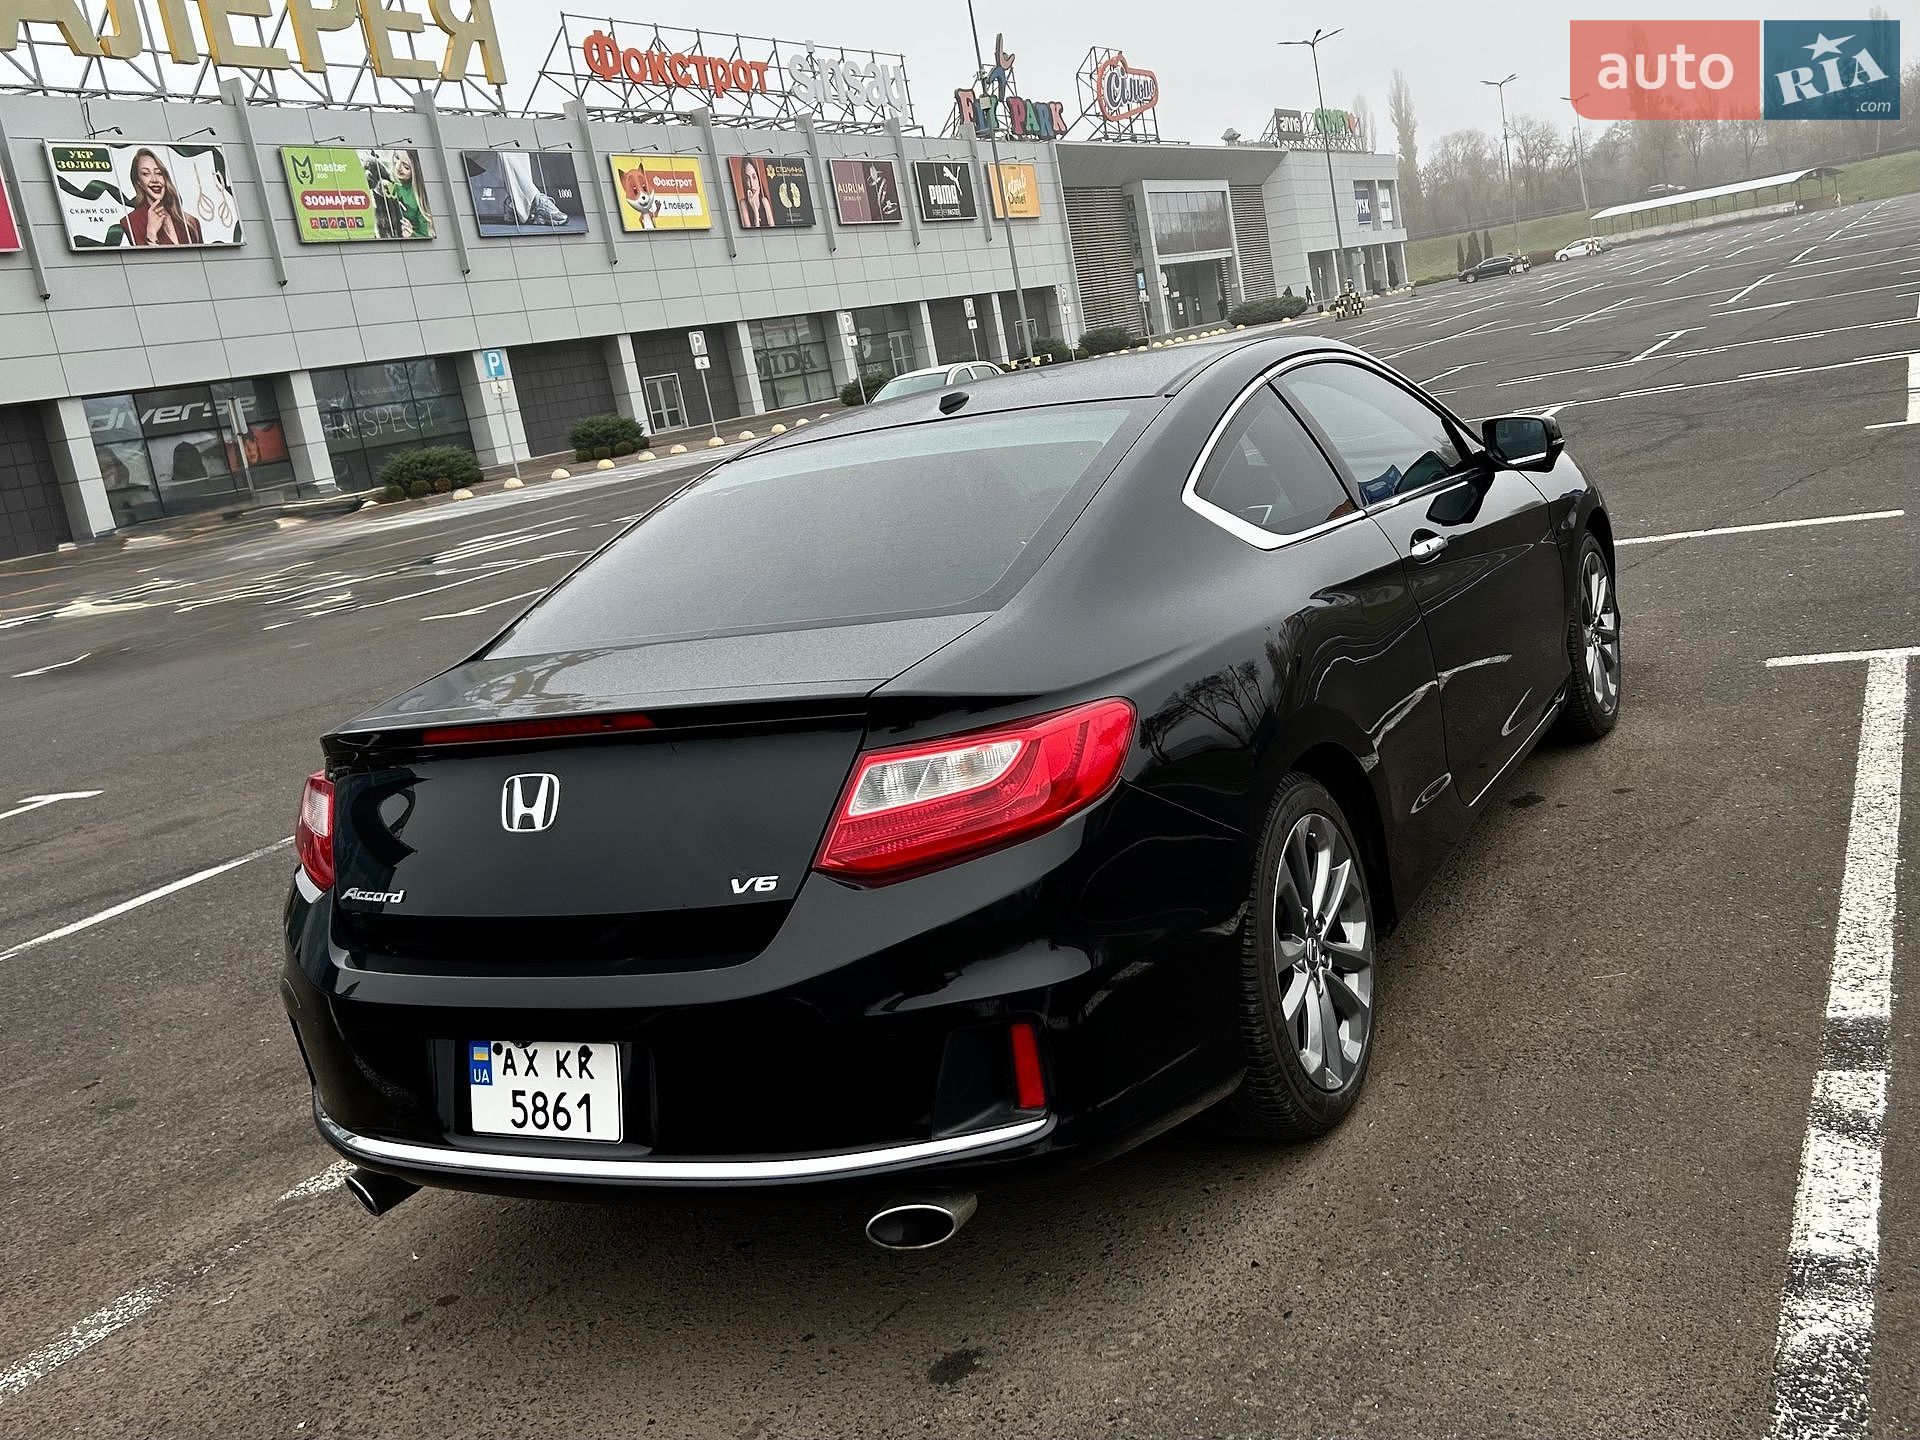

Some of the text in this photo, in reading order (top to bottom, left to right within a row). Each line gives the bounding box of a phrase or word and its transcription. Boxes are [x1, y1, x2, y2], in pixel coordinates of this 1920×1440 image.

[583, 30, 768, 98] Фокстрот
[789, 40, 908, 125] sinsay
[1006, 96, 1067, 139] PARK
[68, 149, 94, 159] УКР
[57, 160, 111, 171] ЗОЛОТО
[314, 162, 347, 173] master
[653, 176, 693, 188] Фокстрот
[837, 183, 865, 194] AURUM
[304, 195, 366, 206] ЗООМАРКЕТ
[928, 185, 958, 205] PUMA
[669, 201, 693, 210] поверх
[692, 334, 702, 353] P
[488, 352, 500, 376] P
[730, 875, 779, 895] V6
[340, 886, 405, 904] Accord
[503, 1048, 539, 1078] AX
[473, 1068, 490, 1083] UA
[511, 1090, 592, 1133] 5861
